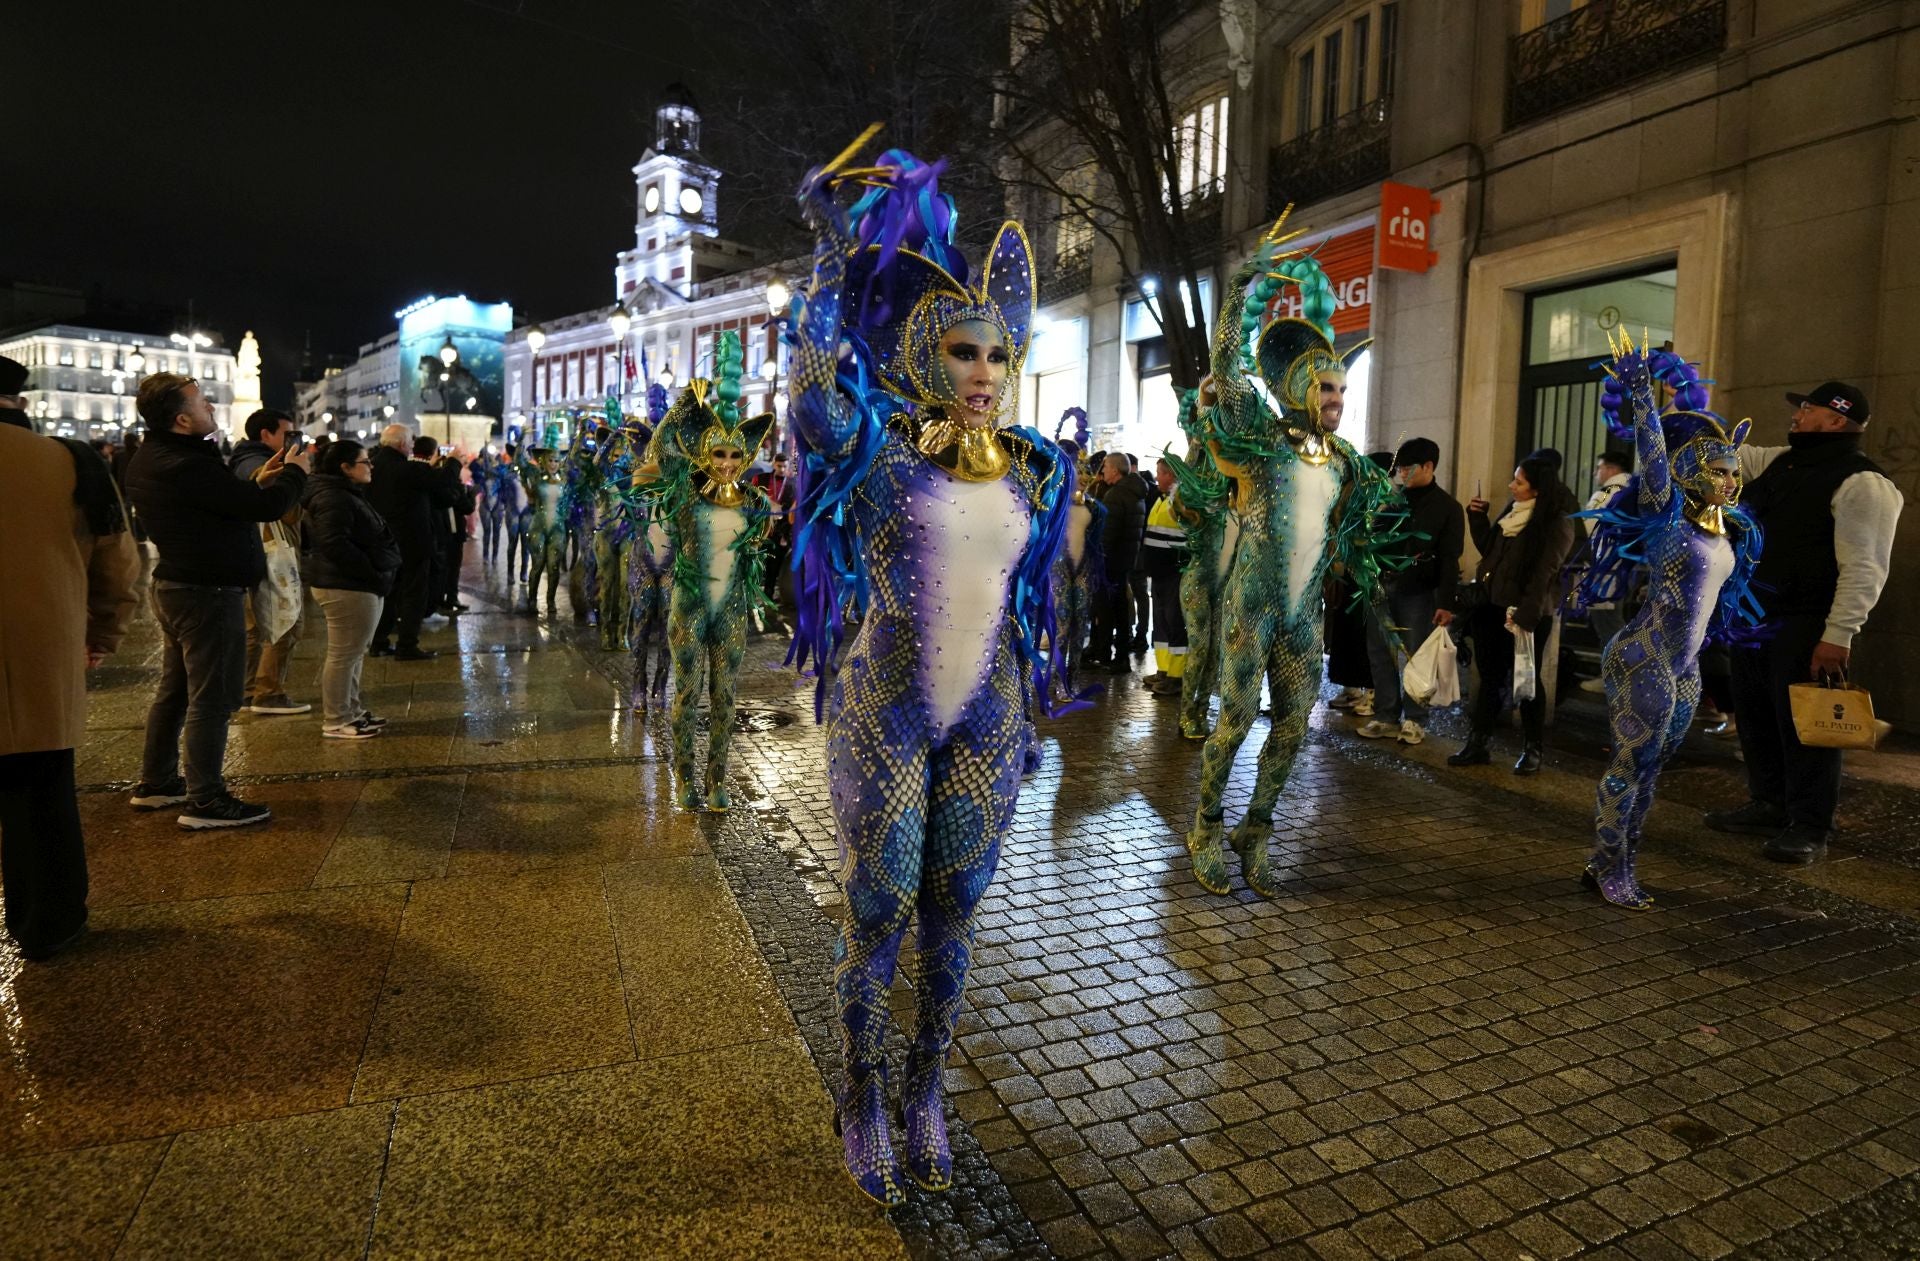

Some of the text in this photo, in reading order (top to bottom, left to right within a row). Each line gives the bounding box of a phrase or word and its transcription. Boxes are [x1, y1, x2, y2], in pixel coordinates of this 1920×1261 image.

[1389, 206, 1425, 240] ria
[1272, 274, 1374, 319] CHNG
[1815, 720, 1862, 731] EL PATIO
